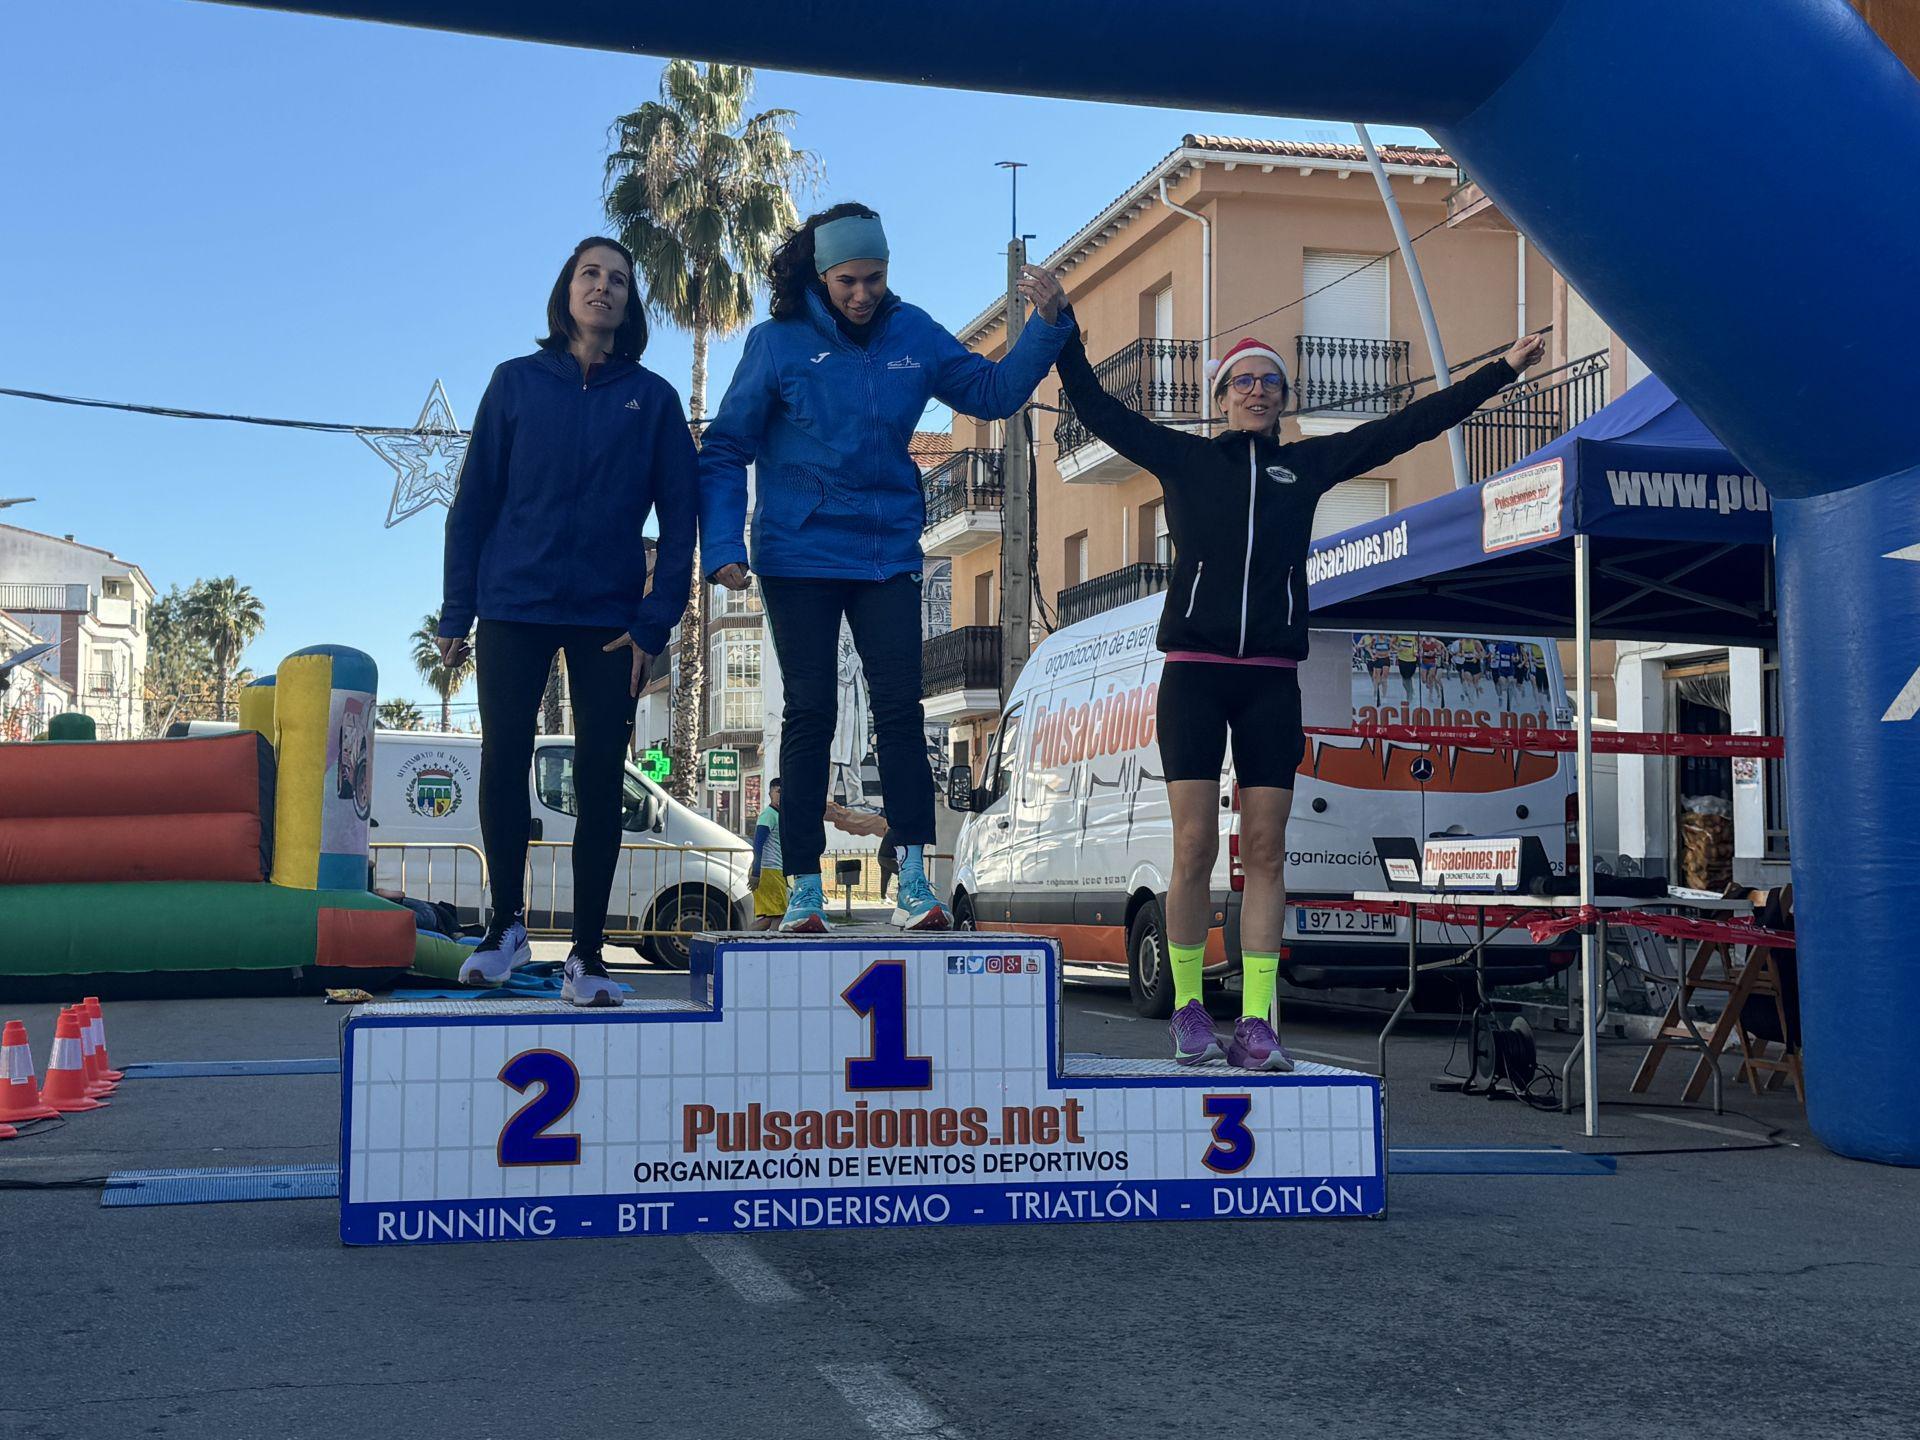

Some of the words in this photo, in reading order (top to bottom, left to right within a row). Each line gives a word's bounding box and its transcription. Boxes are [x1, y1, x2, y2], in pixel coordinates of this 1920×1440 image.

[1606, 470, 1768, 514] www.pu
[1306, 520, 1408, 586] ulsaciones.net
[1045, 634, 1108, 677] organización
[1108, 631, 1125, 656] de
[1029, 682, 1159, 772] Pulsacione
[1284, 850, 1380, 866] rganización
[1424, 846, 1517, 871] Pulsaciones.net
[1311, 912, 1355, 929] 9712
[1360, 913, 1393, 930] JFM
[840, 959, 933, 1092] 1
[497, 1048, 581, 1167] 2
[683, 1098, 1086, 1153] Pulsaciones.net
[1201, 1093, 1255, 1174] 3
[633, 1153, 820, 1183] ORGANIZACIÓN
[828, 1156, 859, 1177] DE
[867, 1153, 976, 1176] EVENTOS
[983, 1150, 1129, 1174] DEPORTIVOS
[378, 1206, 556, 1241] RUNNING
[618, 1202, 675, 1232] BTT
[733, 1193, 950, 1229] SENDERISMO
[1005, 1182, 1158, 1219] TRIATLÓN
[1213, 1179, 1363, 1215] DUATLÓN
